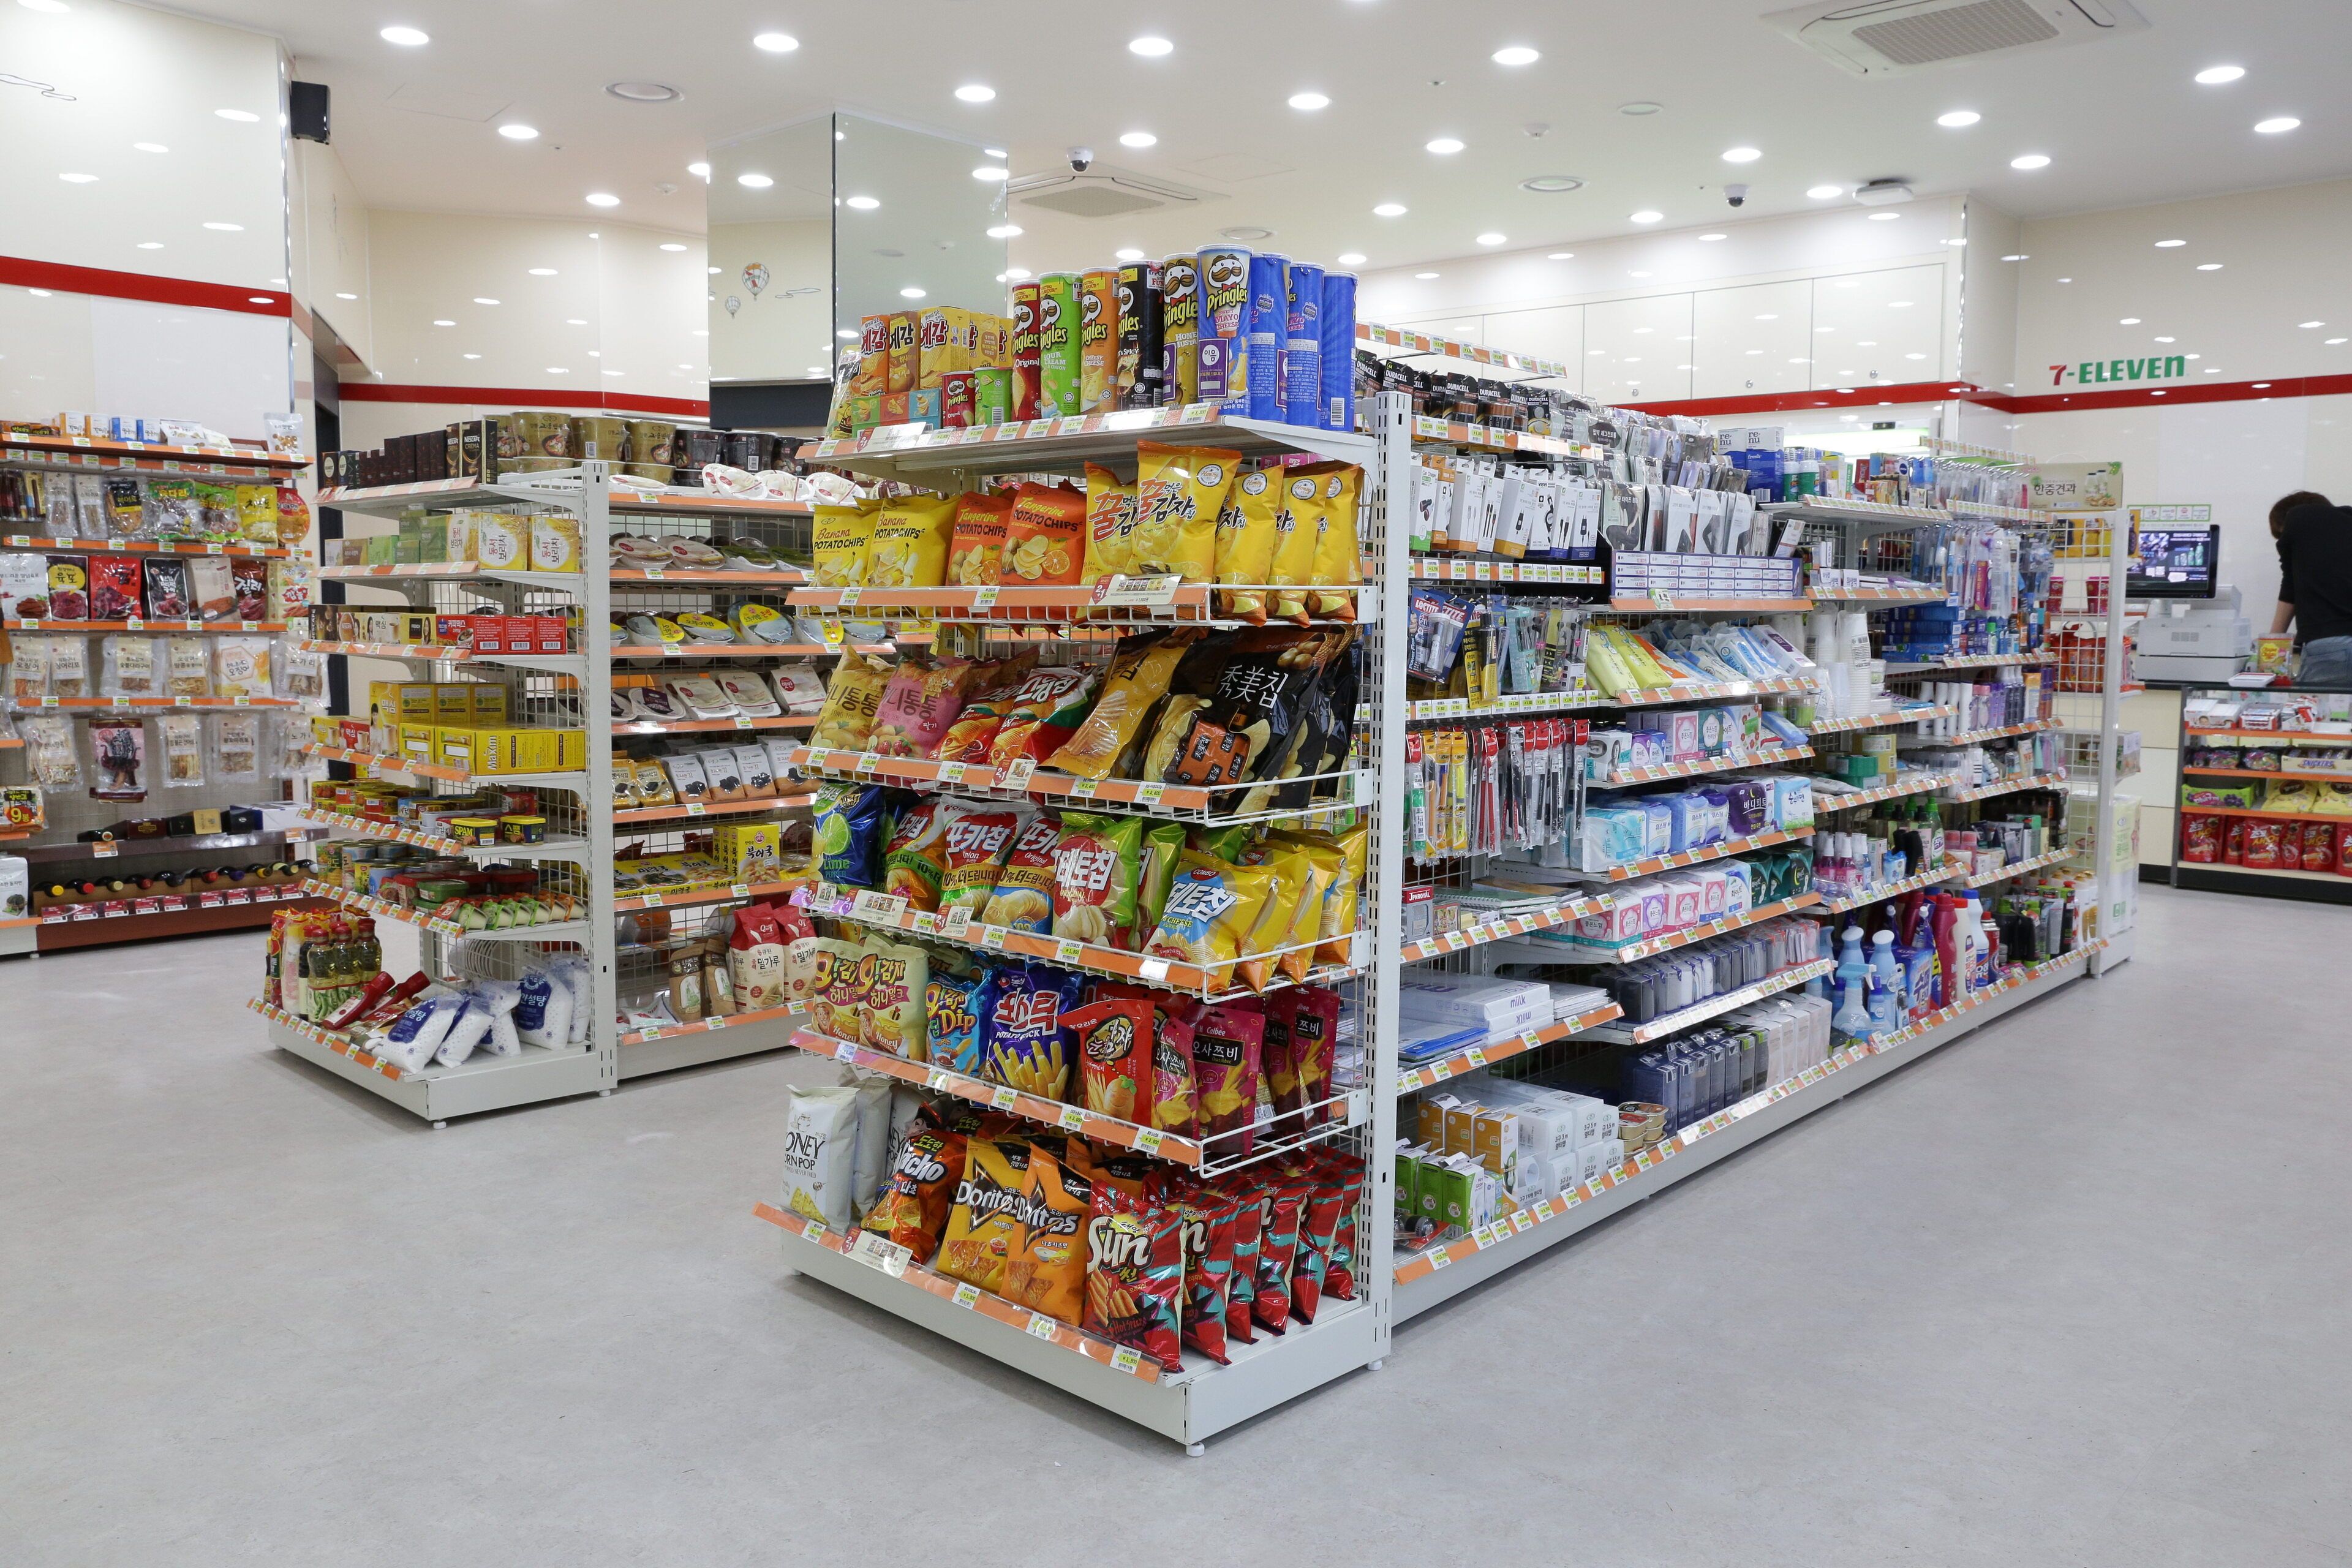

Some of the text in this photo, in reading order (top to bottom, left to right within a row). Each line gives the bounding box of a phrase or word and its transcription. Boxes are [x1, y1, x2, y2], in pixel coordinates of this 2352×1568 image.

[1206, 287, 1248, 317] Pringles
[1215, 314, 1238, 324] MAYO
[1215, 322, 1240, 331] CHEESE
[1043, 352, 1061, 360] SOUR
[1015, 358, 1040, 368] Original
[1356, 361, 1377, 377] DURACELL
[1386, 370, 1408, 382] DURACELL
[1447, 383, 1469, 392] DURACELL
[1480, 389, 1501, 398] DURACELL
[948, 394, 968, 407] Pringles
[1511, 394, 1528, 405] DURACELL
[1020, 497, 1065, 516] Tangerine
[877, 514, 908, 527] Banana
[958, 508, 999, 523] Tangerine
[1014, 510, 1079, 532] POTATO CHIPS
[816, 527, 851, 540] Banana
[874, 528, 920, 540] POTATO CHIPS
[956, 524, 1007, 538] POTATO CHIPS
[814, 536, 865, 550] POTATO CHIPS
[1415, 599, 1439, 612] LOCTITE
[922, 722, 938, 731] 딸기
[486, 734, 497, 770] Maxim
[1744, 798, 1767, 809] 바디피트
[454, 826, 473, 837] SPAM
[946, 821, 1011, 853] 포카칩
[746, 846, 774, 859] 북어국
[963, 851, 979, 860] Onion
[1025, 851, 1047, 865] Original
[638, 864, 669, 874] 미역국
[1193, 868, 1216, 877] COMBO
[968, 869, 1001, 884] 드립니다!
[670, 886, 691, 895] 미역국
[713, 881, 733, 891] 북어국
[1060, 890, 1085, 899] ORIGINAL
[1167, 918, 1193, 927] CHEESE
[1585, 921, 1602, 929] 좋은느낌
[758, 955, 780, 970] 밀가루
[870, 987, 905, 1008] 허니밀크
[1510, 994, 1526, 1008] miilk
[940, 1010, 976, 1035] Dip
[1076, 1019, 1098, 1028] 오리온
[832, 1026, 858, 1042] Honey
[996, 1030, 1018, 1039] POTATO
[1207, 1027, 1226, 1036] Calbee
[875, 1031, 898, 1050] Honey
[1194, 1041, 1238, 1061] 오사쯔비
[913, 1135, 944, 1152] 도도한
[799, 1158, 815, 1170] POP
[1087, 1216, 1152, 1274] Sun
[1129, 1282, 1147, 1293] 오리지널
